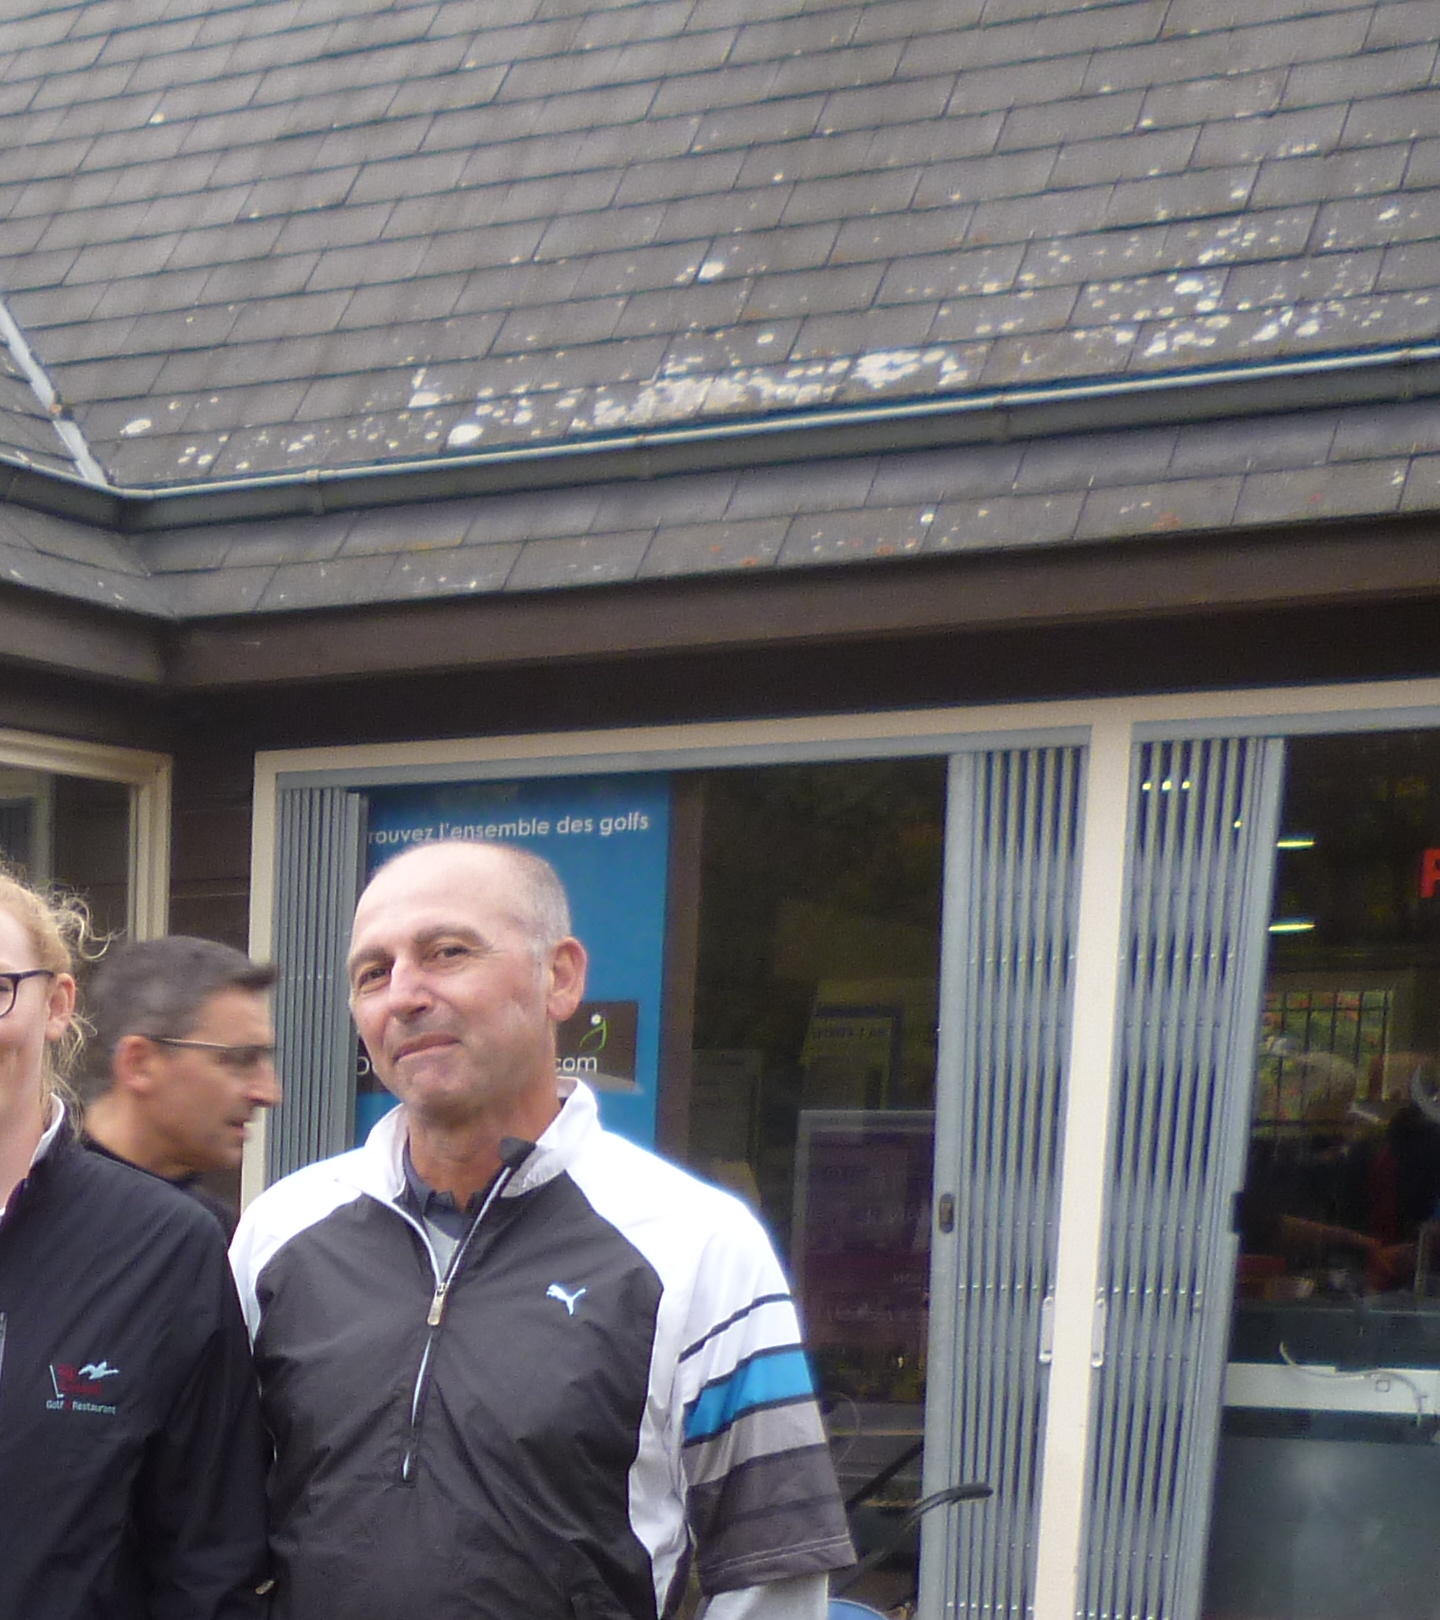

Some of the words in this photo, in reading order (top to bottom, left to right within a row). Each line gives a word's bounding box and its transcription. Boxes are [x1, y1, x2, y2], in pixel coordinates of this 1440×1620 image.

[439, 818, 550, 841] l'ensemble
[556, 813, 593, 835] des
[599, 811, 650, 837] golfs
[72, 1401, 117, 1415] Restaurant
